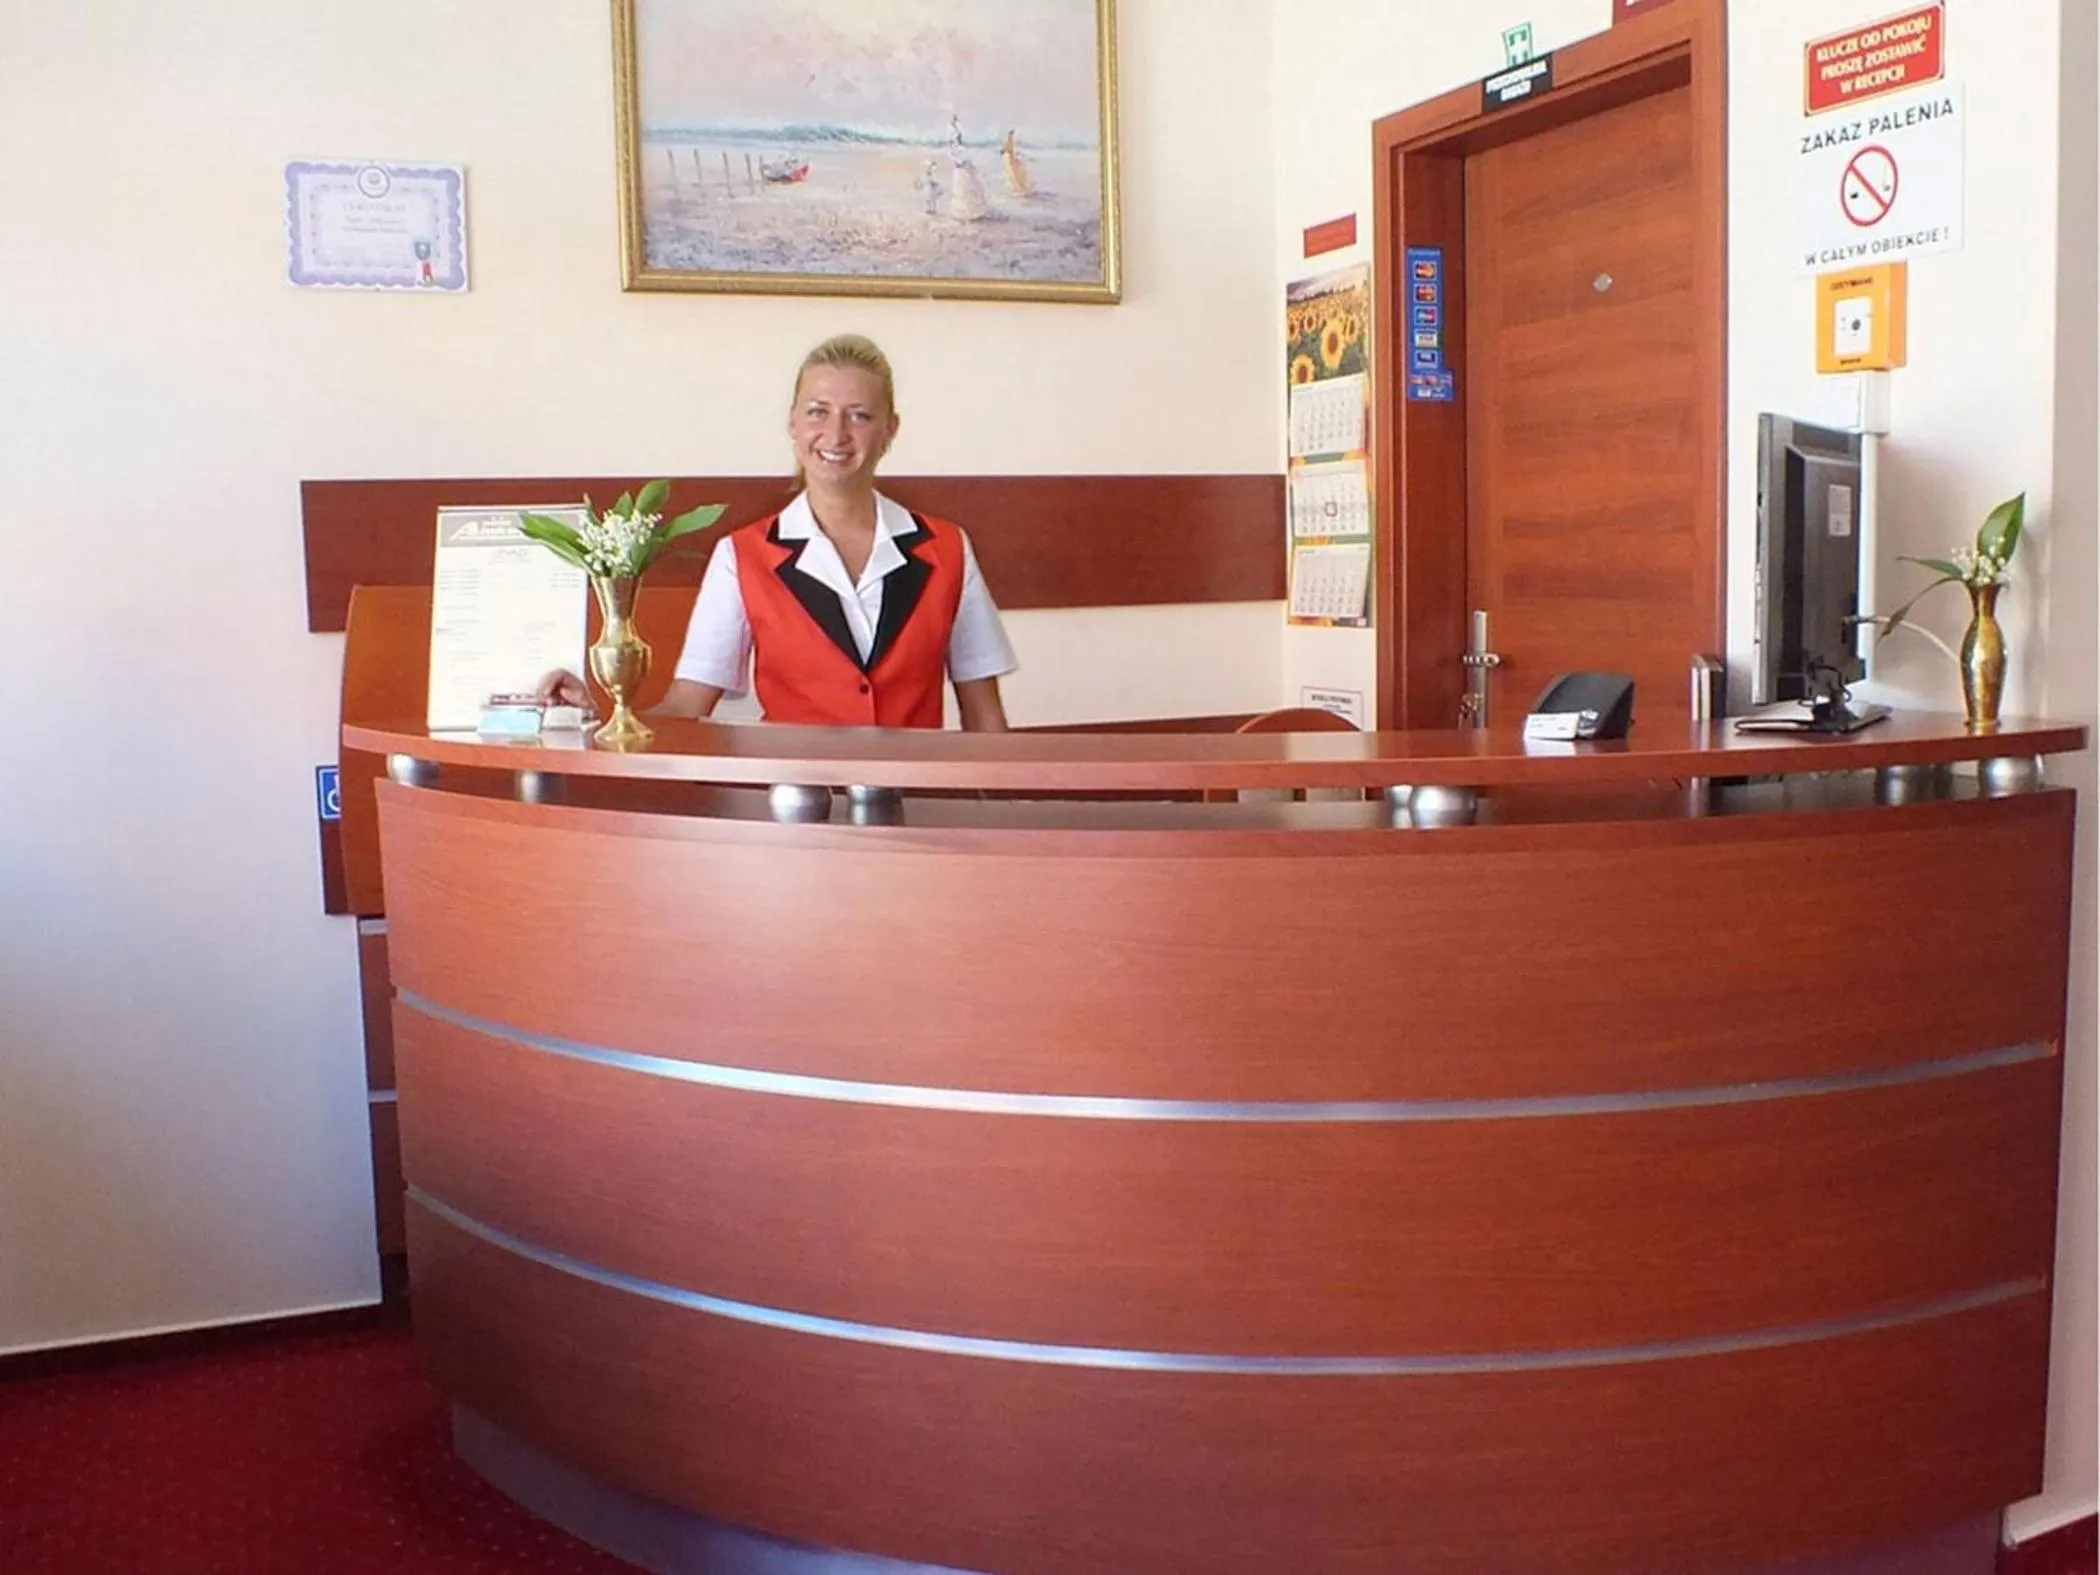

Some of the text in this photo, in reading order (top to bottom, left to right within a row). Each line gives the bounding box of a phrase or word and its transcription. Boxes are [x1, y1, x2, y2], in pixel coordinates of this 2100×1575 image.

[1816, 14, 1932, 62] KLUCZE OD POKOJU
[1865, 33, 1927, 67] ZOSTAWIĆ
[1840, 63, 1905, 94] W RECEPCJI
[1800, 98, 1954, 155] ZAKAZ PALENIA
[1805, 252, 1818, 267] W
[1820, 242, 1868, 264] CAŁYM
[1871, 228, 1940, 255] OBIEKCIE
